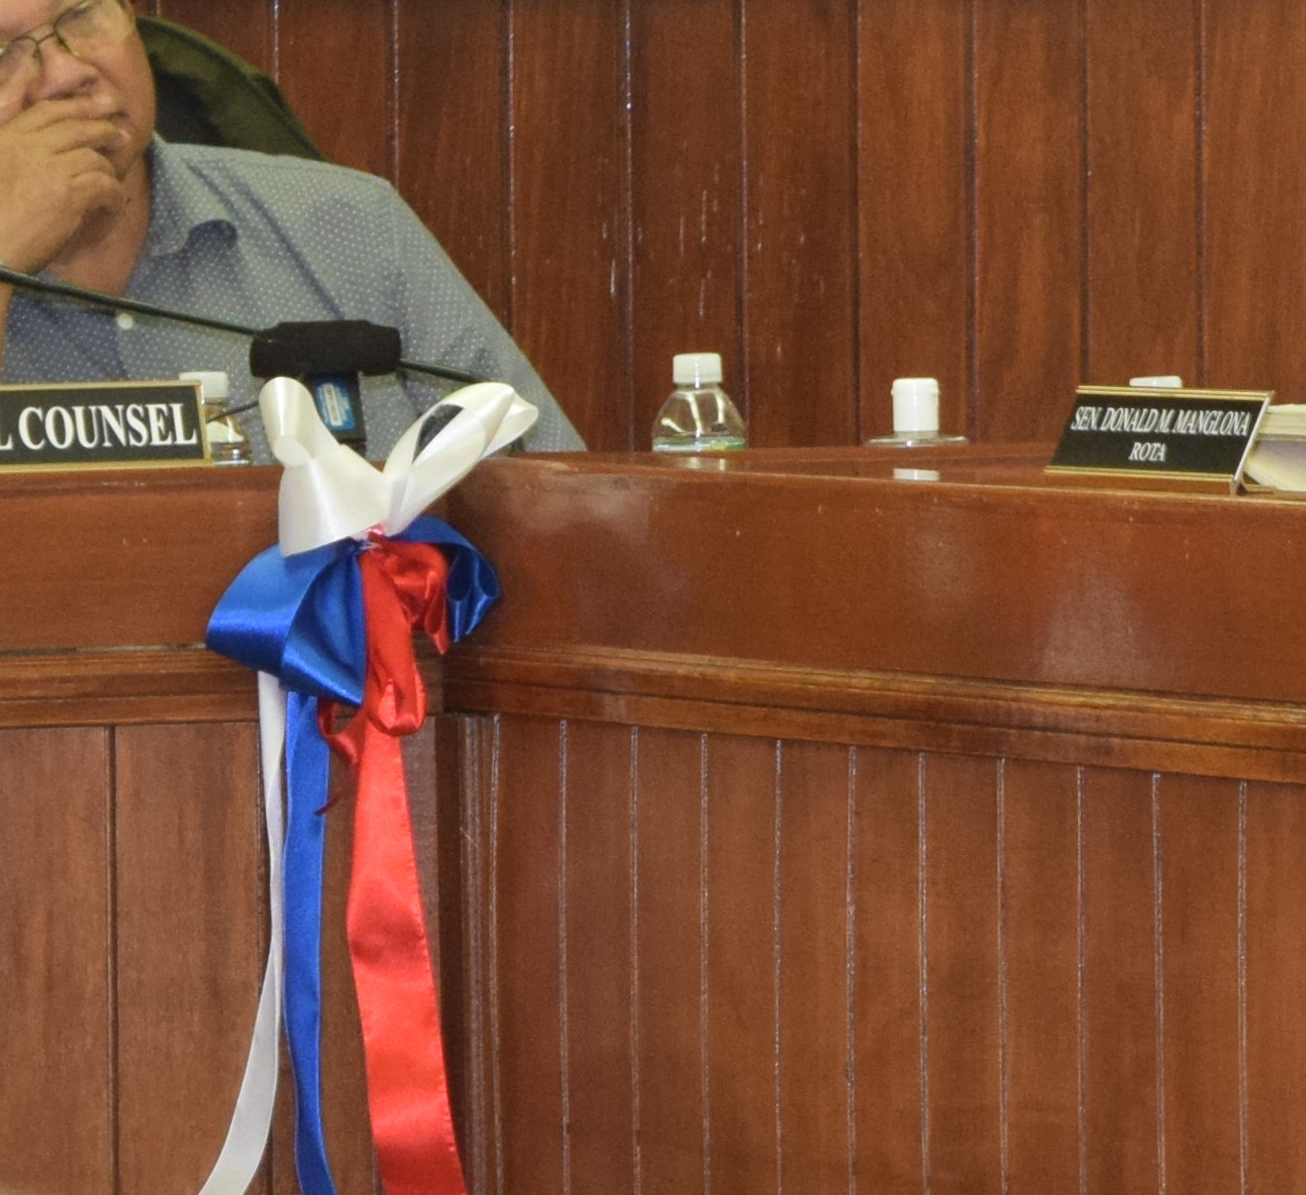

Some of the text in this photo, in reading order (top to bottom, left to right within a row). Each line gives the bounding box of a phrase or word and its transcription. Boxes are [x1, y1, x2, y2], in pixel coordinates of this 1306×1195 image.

[18, 403, 198, 450] COUNSEL
[1070, 406, 1252, 436] SEN. DONALD M. MANGLONA
[1129, 442, 1167, 462] ROTA
